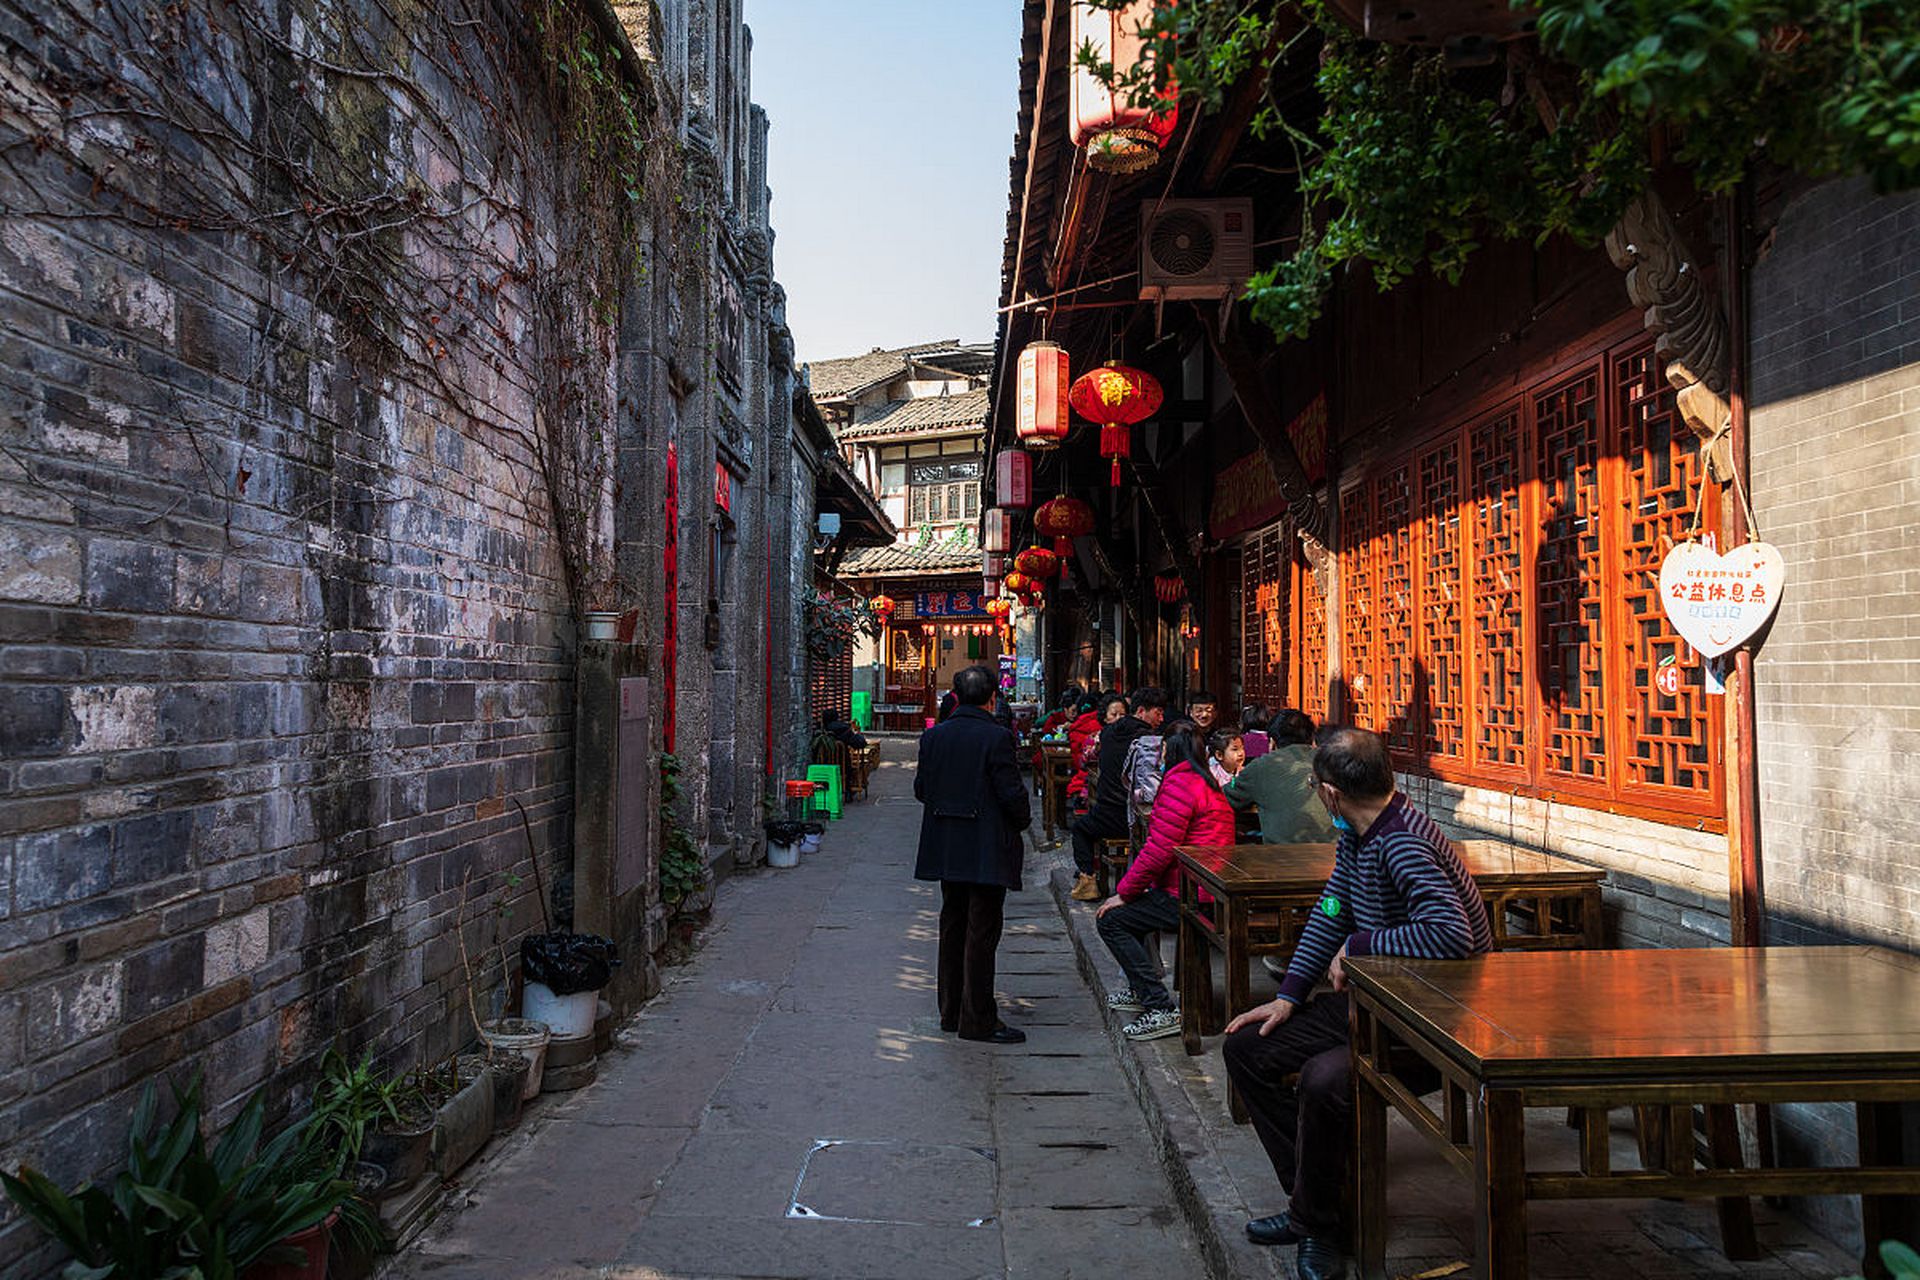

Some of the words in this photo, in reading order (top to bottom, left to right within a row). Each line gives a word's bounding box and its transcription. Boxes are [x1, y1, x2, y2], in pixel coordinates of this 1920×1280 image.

[1671, 581, 1766, 604] 公益休息点
